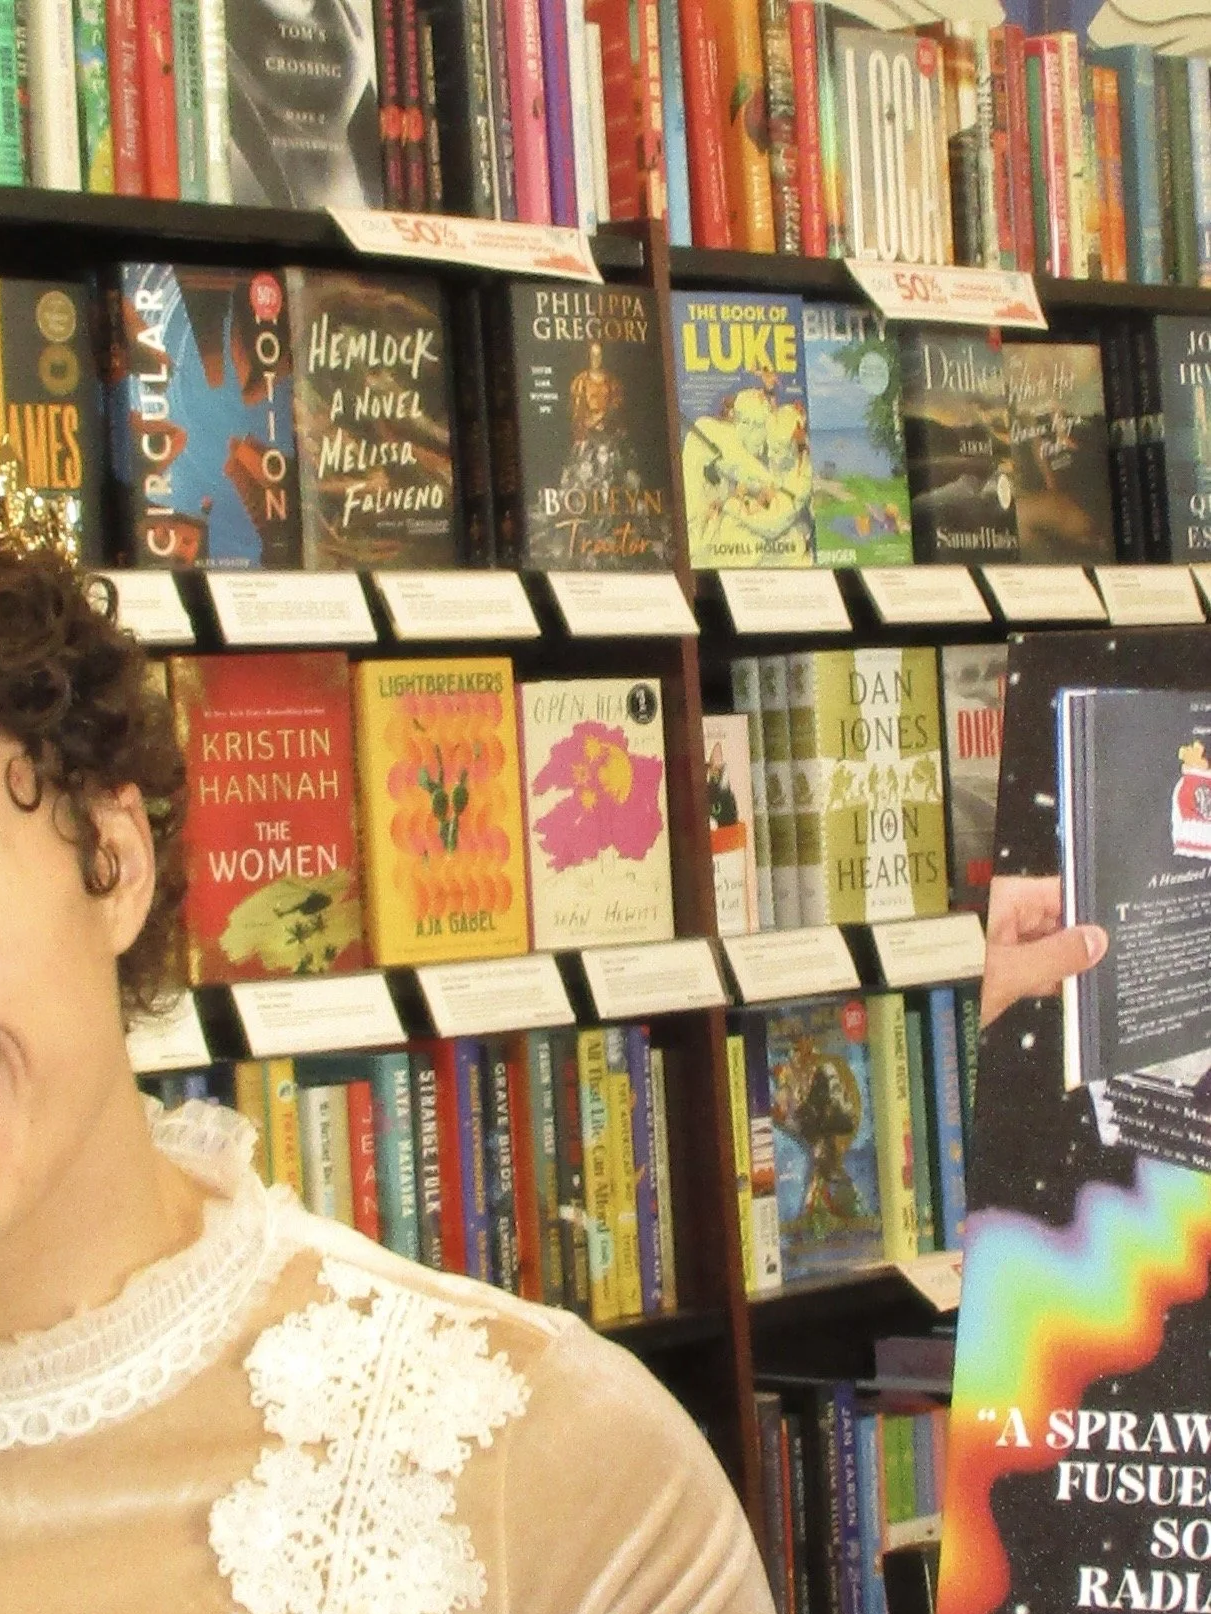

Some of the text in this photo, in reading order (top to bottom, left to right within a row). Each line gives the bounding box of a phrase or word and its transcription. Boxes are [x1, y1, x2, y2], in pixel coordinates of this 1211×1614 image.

[277, 23, 328, 42] TOM'S
[264, 56, 342, 78] CROSSING
[535, 292, 644, 317] PHILIPPA
[687, 304, 788, 322] THE BOOK OF
[309, 312, 438, 380] HEMLOCK
[533, 317, 648, 343] GREGORY
[682, 323, 797, 373] LUKE
[136, 287, 176, 557] CIRCULAR
[255, 313, 287, 521] OTION
[330, 386, 422, 421] A NOVEL
[543, 487, 662, 516] BOLEYN
[555, 518, 649, 557] Traitor
[379, 671, 503, 698] LIGHTBREAKERS
[847, 669, 914, 706] DAN
[202, 728, 331, 762] KRISTIN
[839, 714, 929, 758] JONES
[199, 770, 339, 806] HANNAH
[255, 821, 291, 841] THE
[853, 806, 920, 845] LION
[208, 844, 337, 883] WOMEN
[837, 850, 939, 892] HEARTS
[416, 910, 496, 938] AJA GABEL
[418, 1069, 442, 1215] STRANGE FOLK
[494, 1061, 513, 1193] GRAVE BIRDS
[591, 1145, 607, 1178] Can
[1045, 1408, 1211, 1454] SPRAW
[1055, 1461, 1211, 1507] FUSUE
[1150, 1517, 1211, 1561] SO
